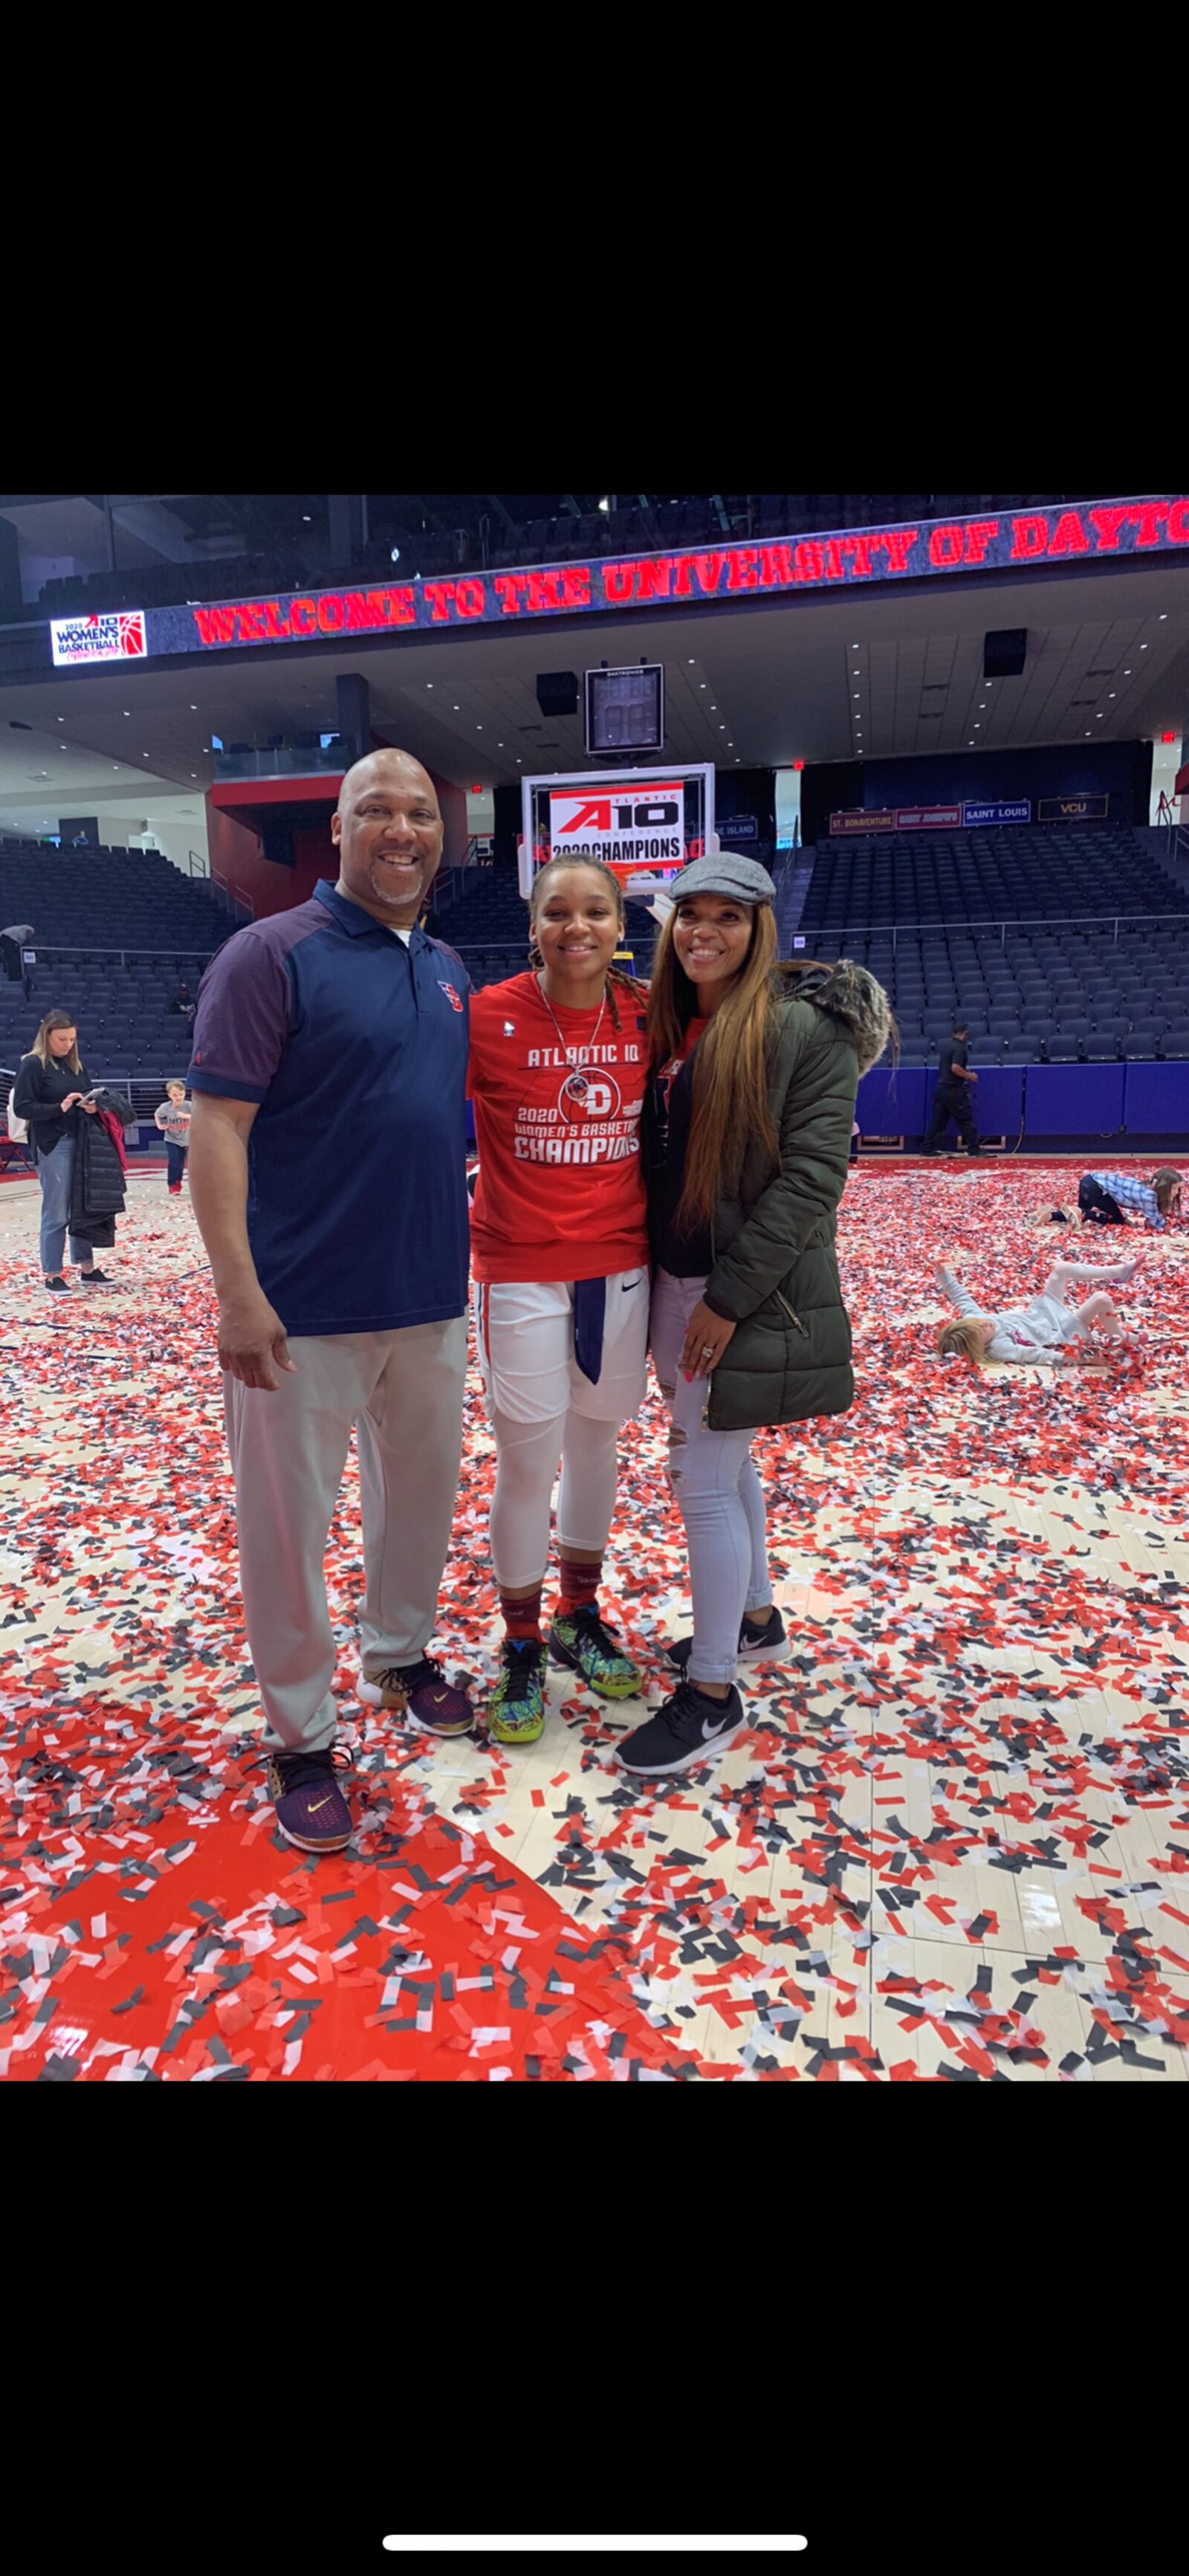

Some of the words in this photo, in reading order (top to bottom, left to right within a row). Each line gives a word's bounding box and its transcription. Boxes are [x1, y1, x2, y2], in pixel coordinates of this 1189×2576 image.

[193, 587, 415, 645] WELCOME
[424, 580, 485, 620] TO
[495, 567, 592, 613] THE
[602, 530, 919, 601] UNIVERSITY
[929, 522, 1000, 566] OF
[56, 626, 119, 644] WOMEN'S
[58, 639, 120, 653] BASKETBALL
[966, 810, 996, 819] SAINT
[999, 807, 1028, 817] LOUIS
[1060, 803, 1086, 813] VCU
[845, 816, 892, 827] BONAVENTURE
[597, 827, 676, 839] CONFERENCE
[727, 825, 754, 835] ISLAND
[592, 837, 680, 862] CHAMPIONS
[528, 1045, 618, 1068] ATLANTIC
[518, 1108, 557, 1123] 2020
[514, 1123, 578, 1138] WOMEN'S
